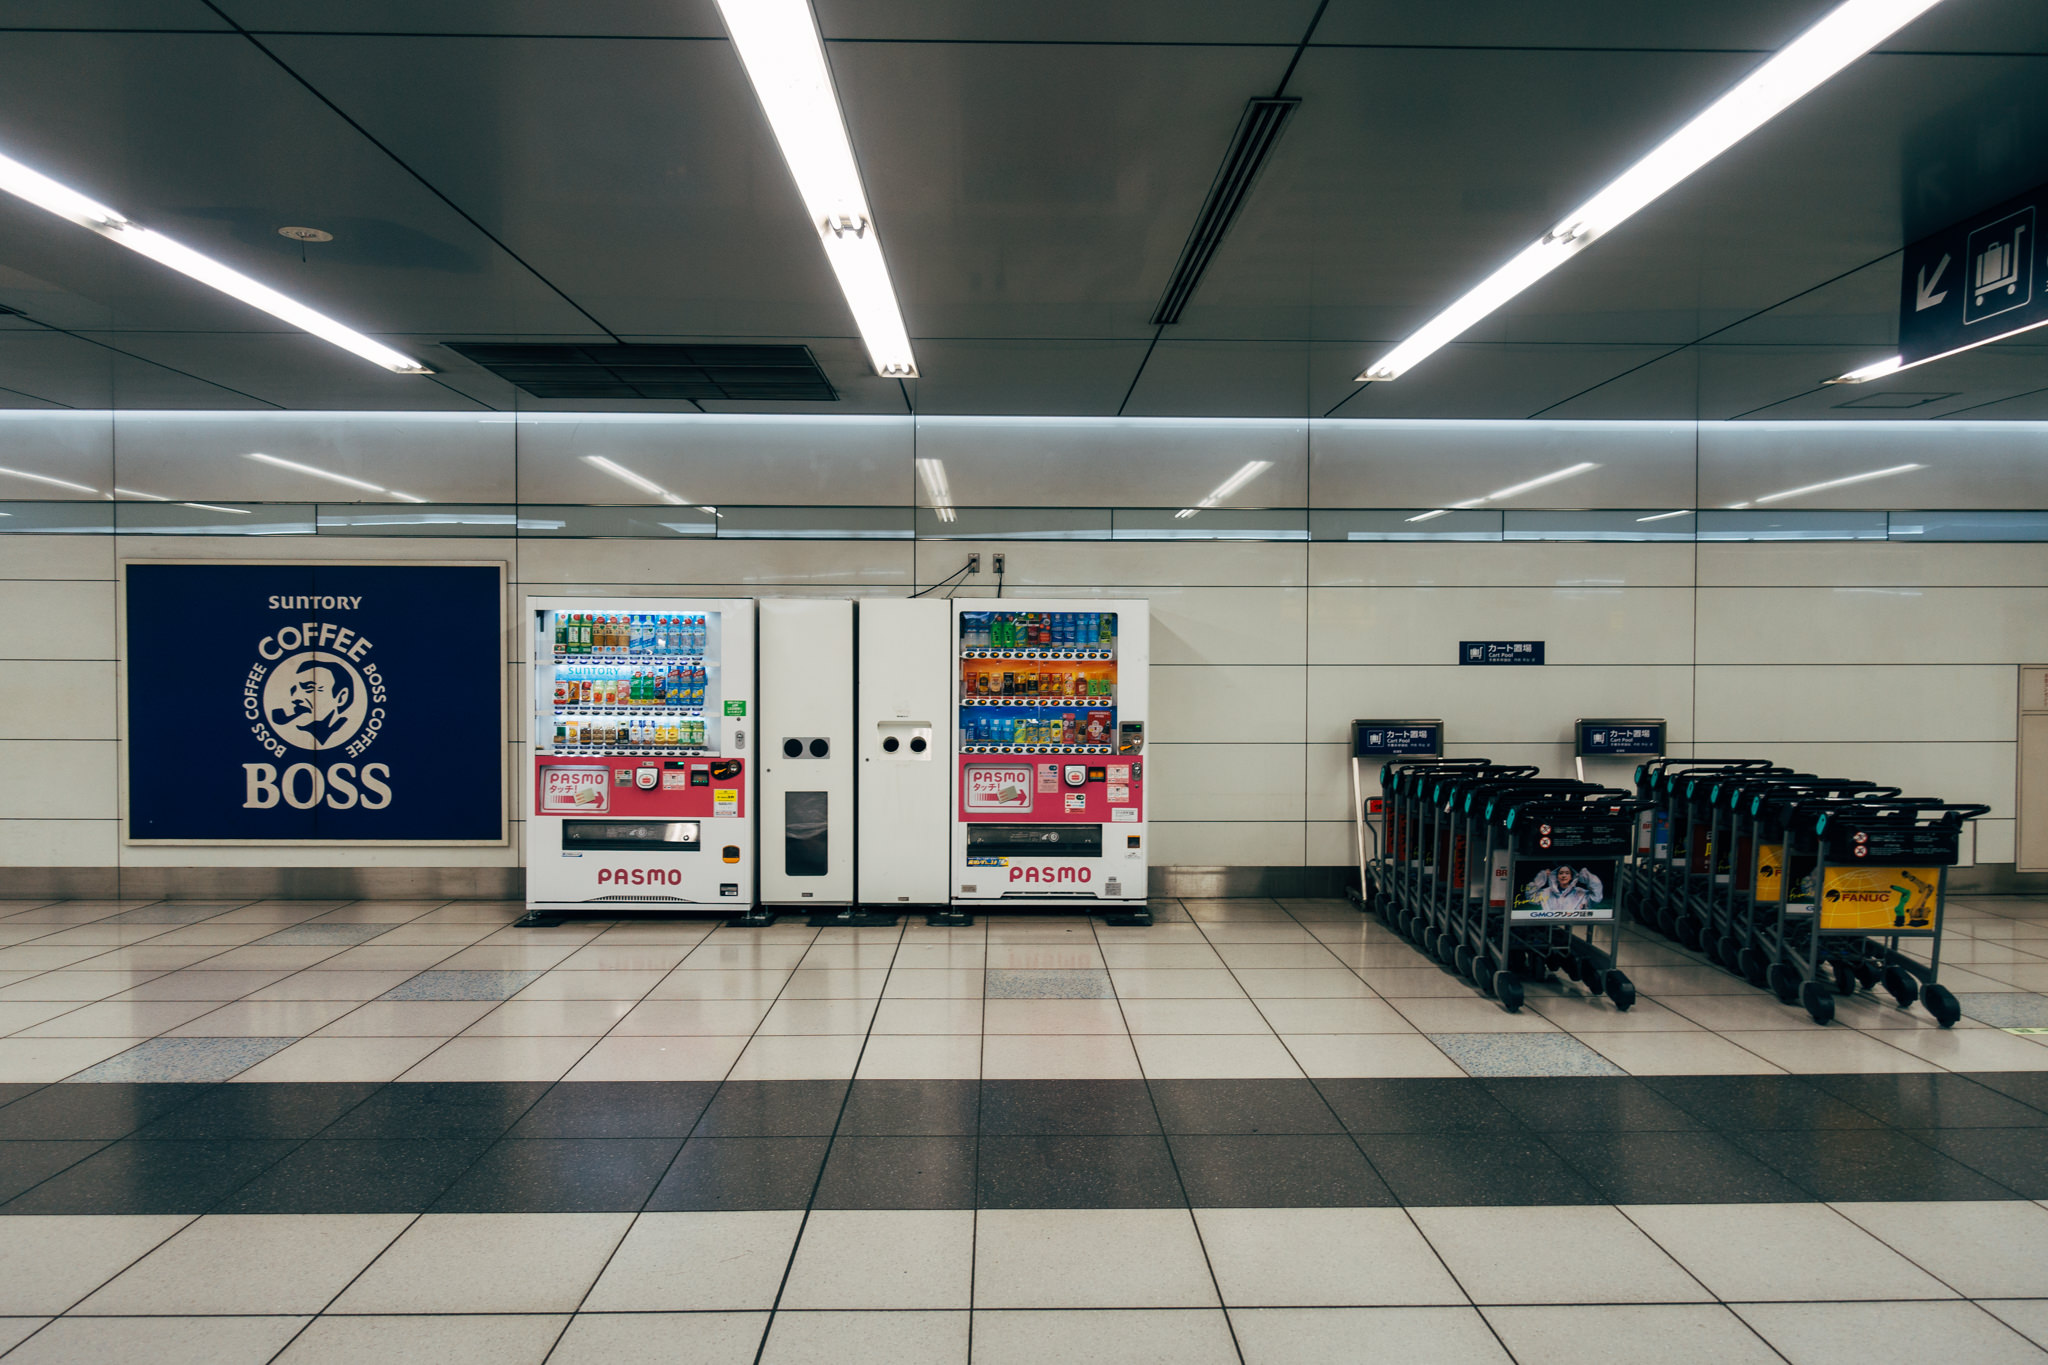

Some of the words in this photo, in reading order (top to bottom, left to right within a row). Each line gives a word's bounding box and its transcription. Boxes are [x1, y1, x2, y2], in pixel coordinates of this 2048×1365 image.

[268, 595, 362, 610] SUNTORY
[258, 622, 373, 662] COFFEE
[1488, 643, 1532, 653] カート置場
[244, 662, 267, 720] COFFEE
[363, 663, 387, 703] BOSS
[252, 722, 287, 759] BOSS
[345, 707, 386, 759] COFFEE
[1386, 730, 1428, 739] カート置場
[1609, 729, 1651, 738] カート置場
[241, 762, 393, 810] BOSS
[550, 773, 604, 785] PASMO
[973, 771, 1026, 783] PASMO
[597, 868, 682, 886] PASMO
[1008, 865, 1092, 884] PASMO
[1841, 893, 1892, 903] FANUC
